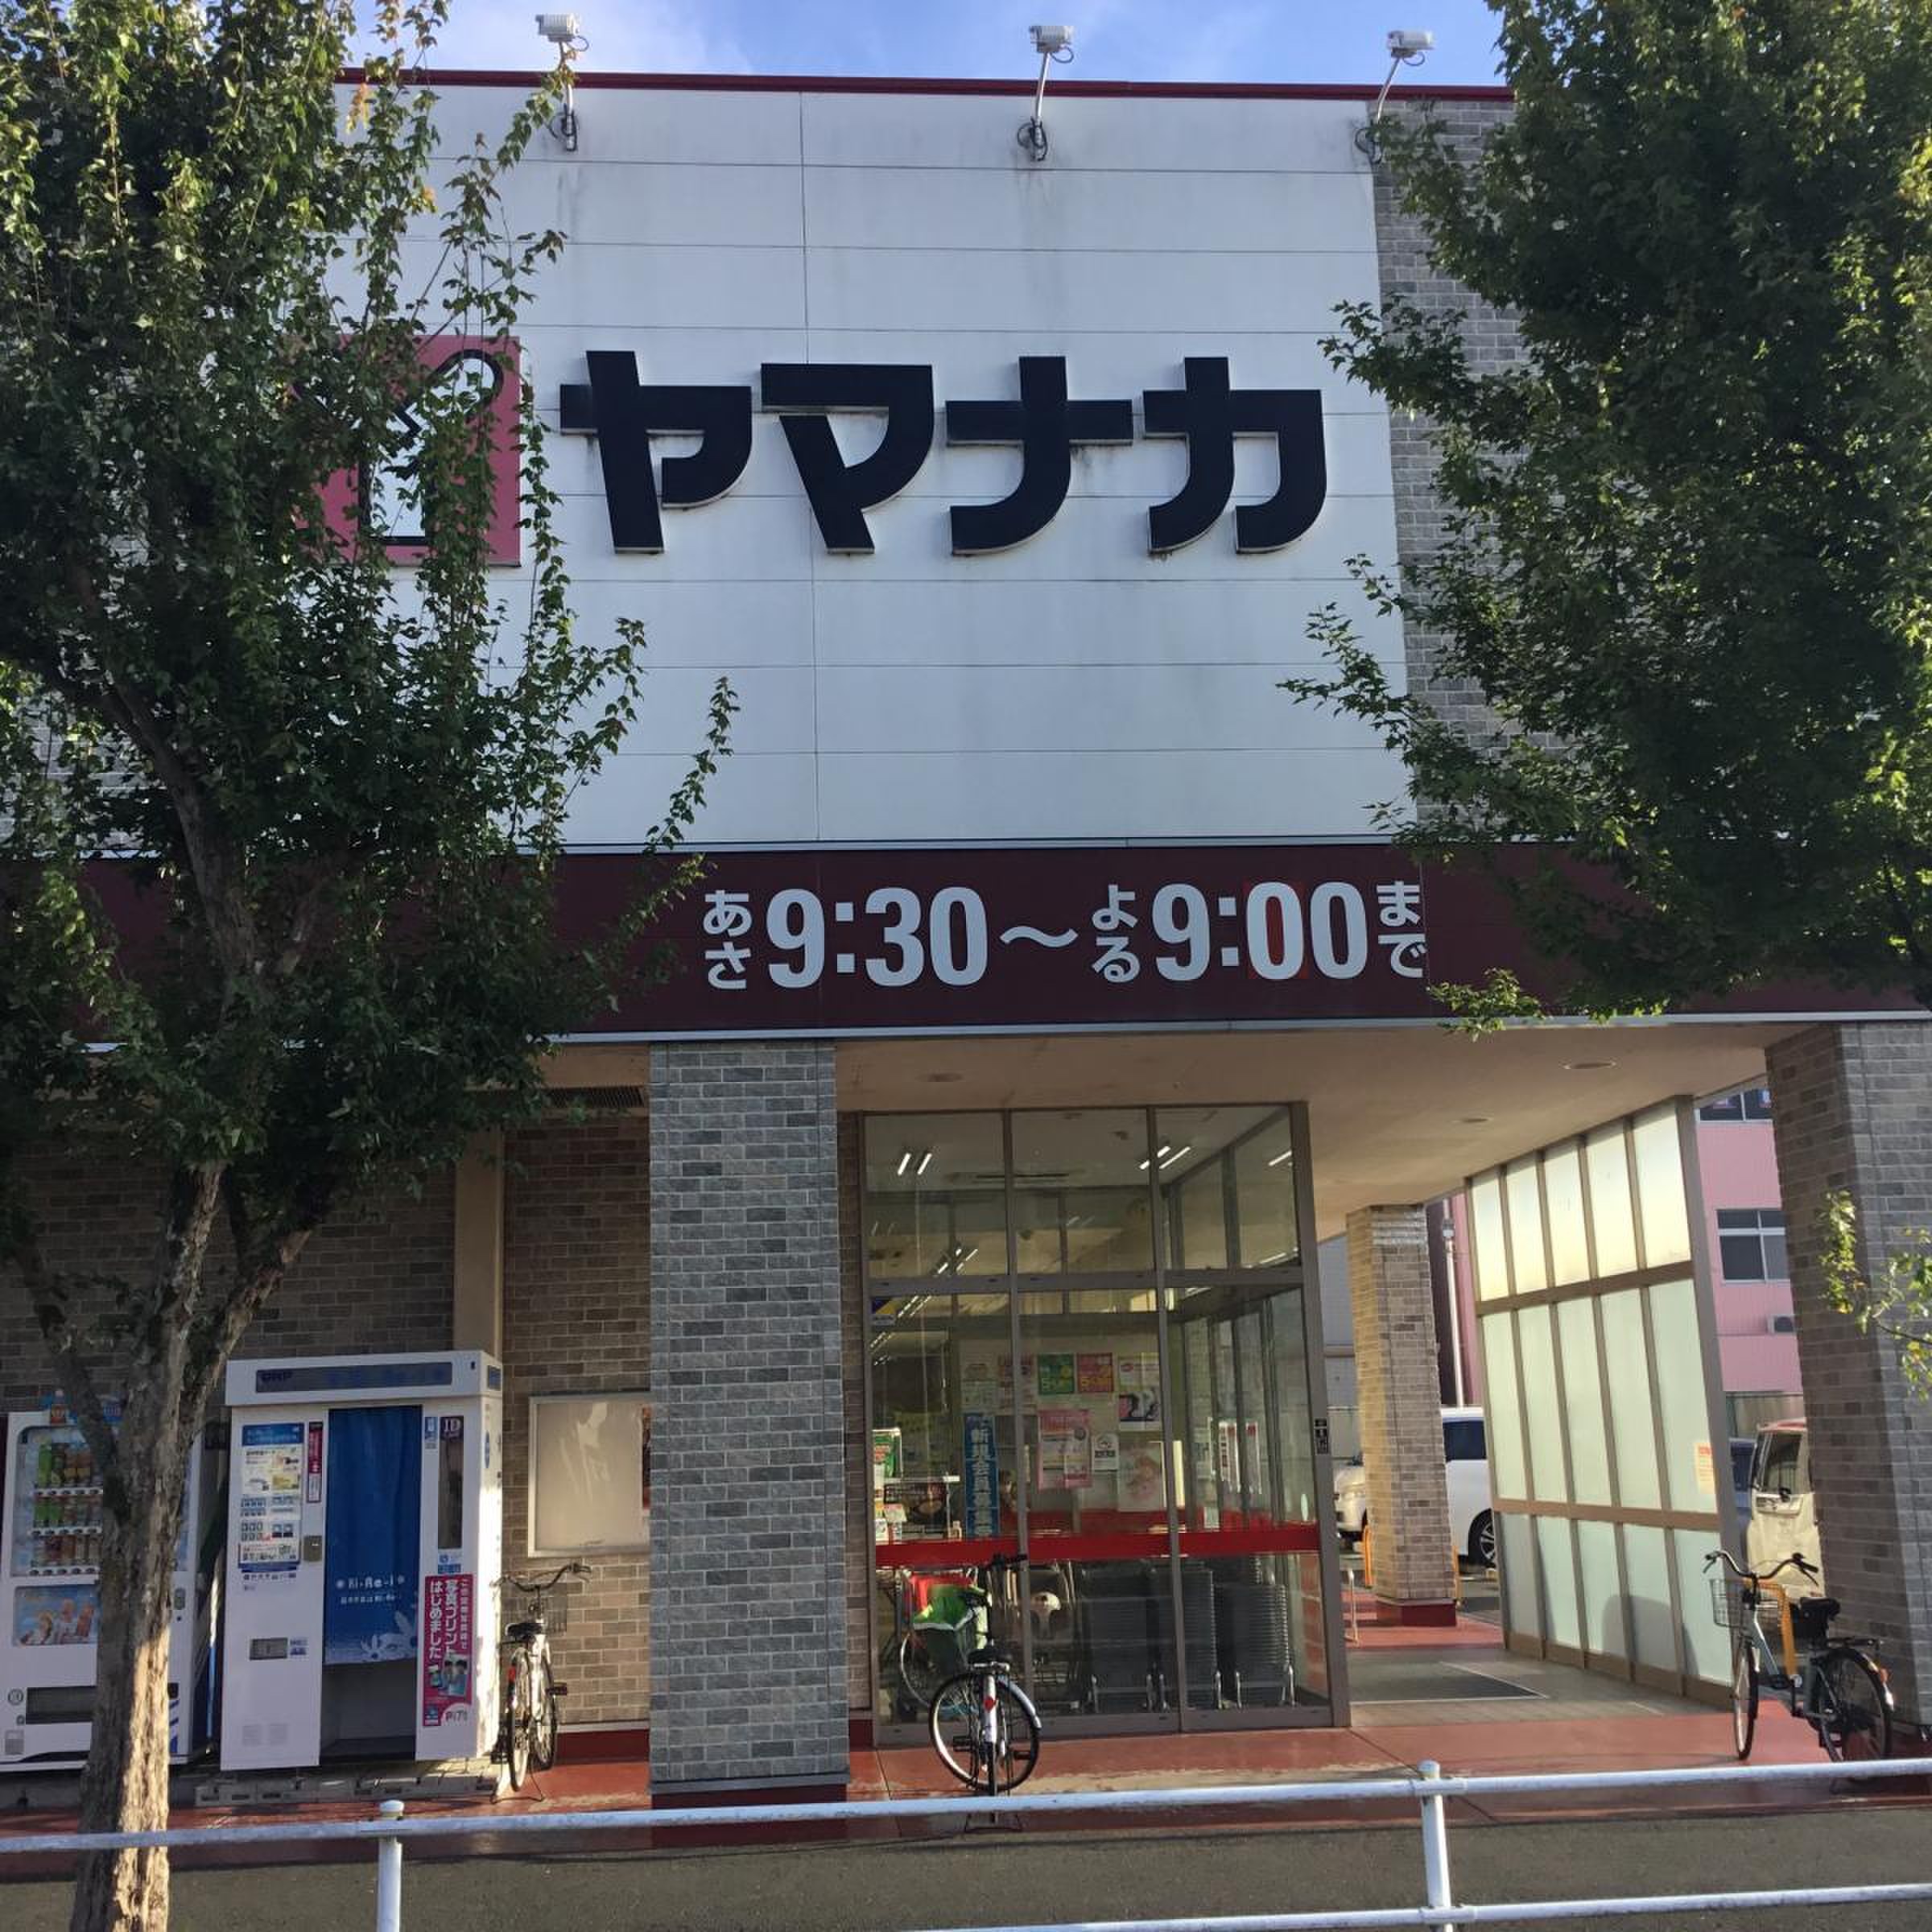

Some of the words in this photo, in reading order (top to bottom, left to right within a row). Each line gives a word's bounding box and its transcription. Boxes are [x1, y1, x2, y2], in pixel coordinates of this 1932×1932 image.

[560, 350, 1327, 554] ヤマナカ
[703, 890, 753, 989] あさ
[766, 886, 989, 989] 9:30
[1092, 884, 1141, 983] よる
[1152, 881, 1368, 981] 9:00
[1376, 881, 1428, 978] まで
[428, 1579, 443, 1659] はじめました
